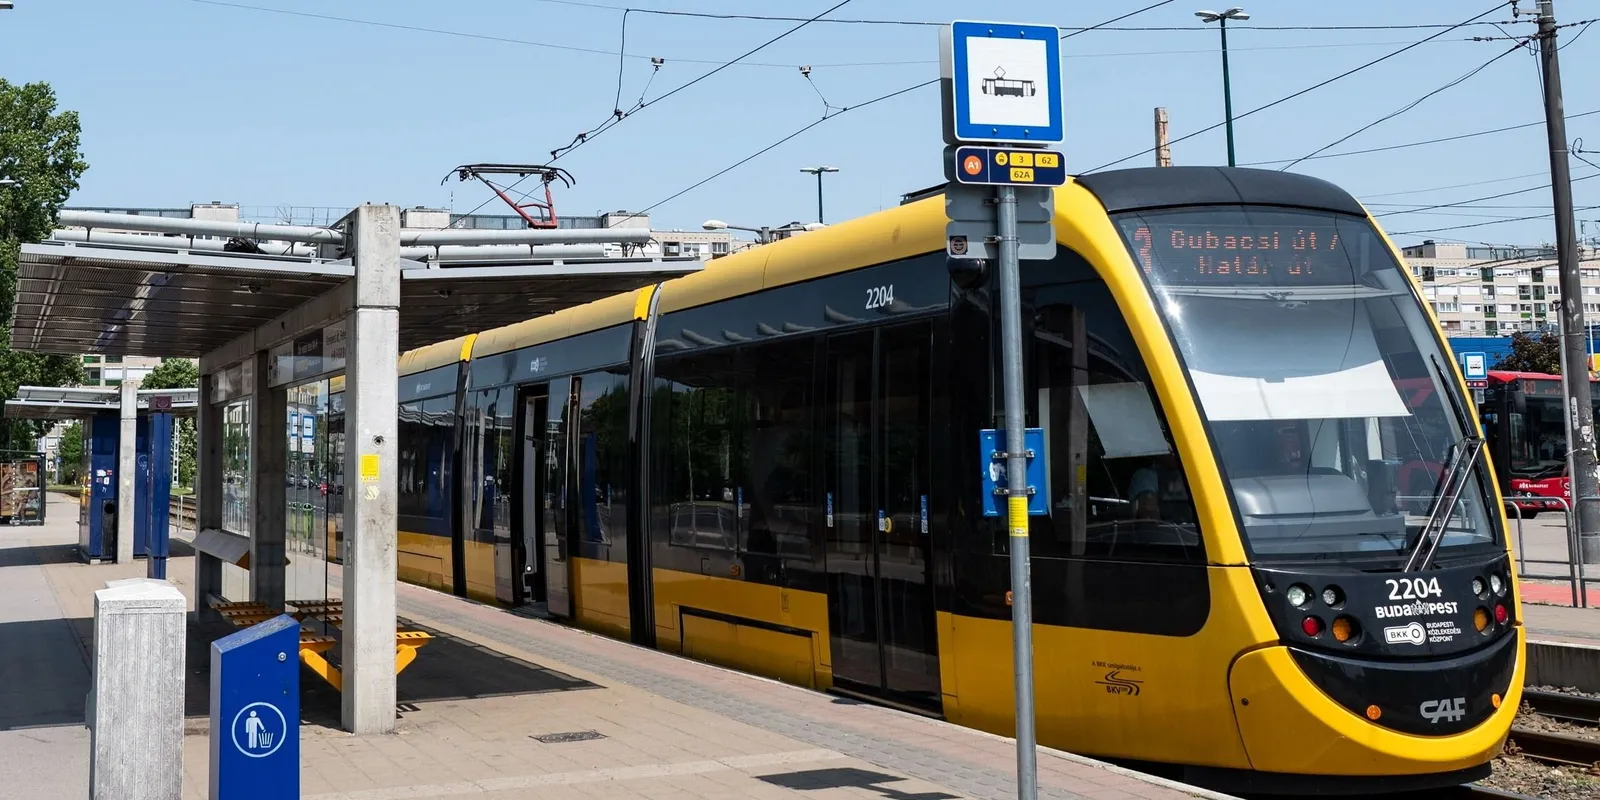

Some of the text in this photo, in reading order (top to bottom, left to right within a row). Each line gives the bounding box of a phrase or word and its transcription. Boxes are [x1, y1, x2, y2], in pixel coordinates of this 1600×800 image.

[967, 161, 979, 169] A1
[1014, 170, 1031, 178] 62A
[1171, 230, 1279, 250] Gubacsi
[1292, 229, 1317, 250] út
[865, 284, 894, 309] 2204
[1385, 577, 1442, 600] 2204
[1426, 621, 1454, 629] BUDAPESTI
[1390, 631, 1408, 639] BKK
[1429, 635, 1453, 643] KÖZPONT
[1106, 685, 1121, 694] BKV
[1420, 697, 1466, 724] CAF
